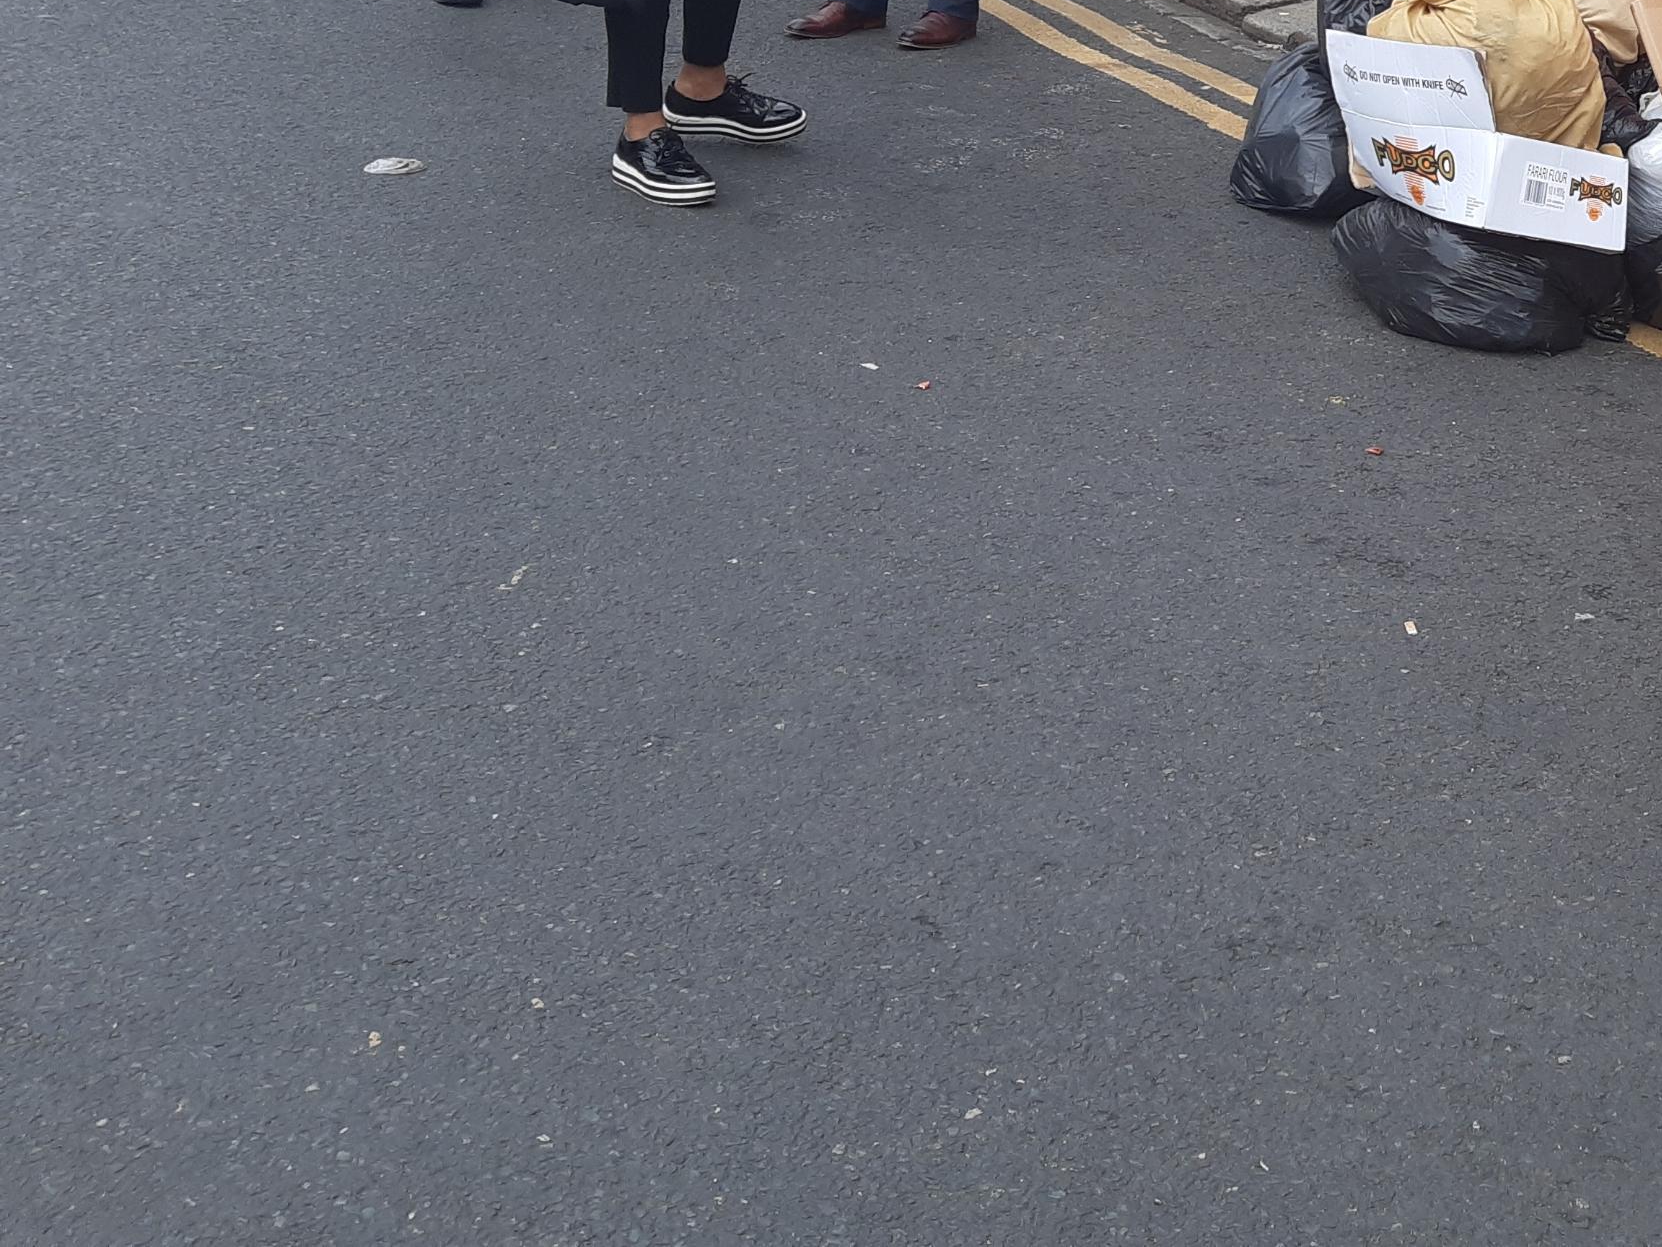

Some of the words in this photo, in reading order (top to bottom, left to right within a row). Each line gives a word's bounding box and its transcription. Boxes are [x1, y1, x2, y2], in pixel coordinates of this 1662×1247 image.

[1359, 69, 1369, 81] DO
[1369, 71, 1382, 83] NOT
[1383, 74, 1400, 86] OPEN
[1401, 76, 1421, 88] WITH
[1421, 78, 1444, 91] KNIFE
[1371, 136, 1456, 186] FUDCO
[1548, 167, 1568, 184] FLOUR
[1569, 177, 1623, 208] FUDCO
